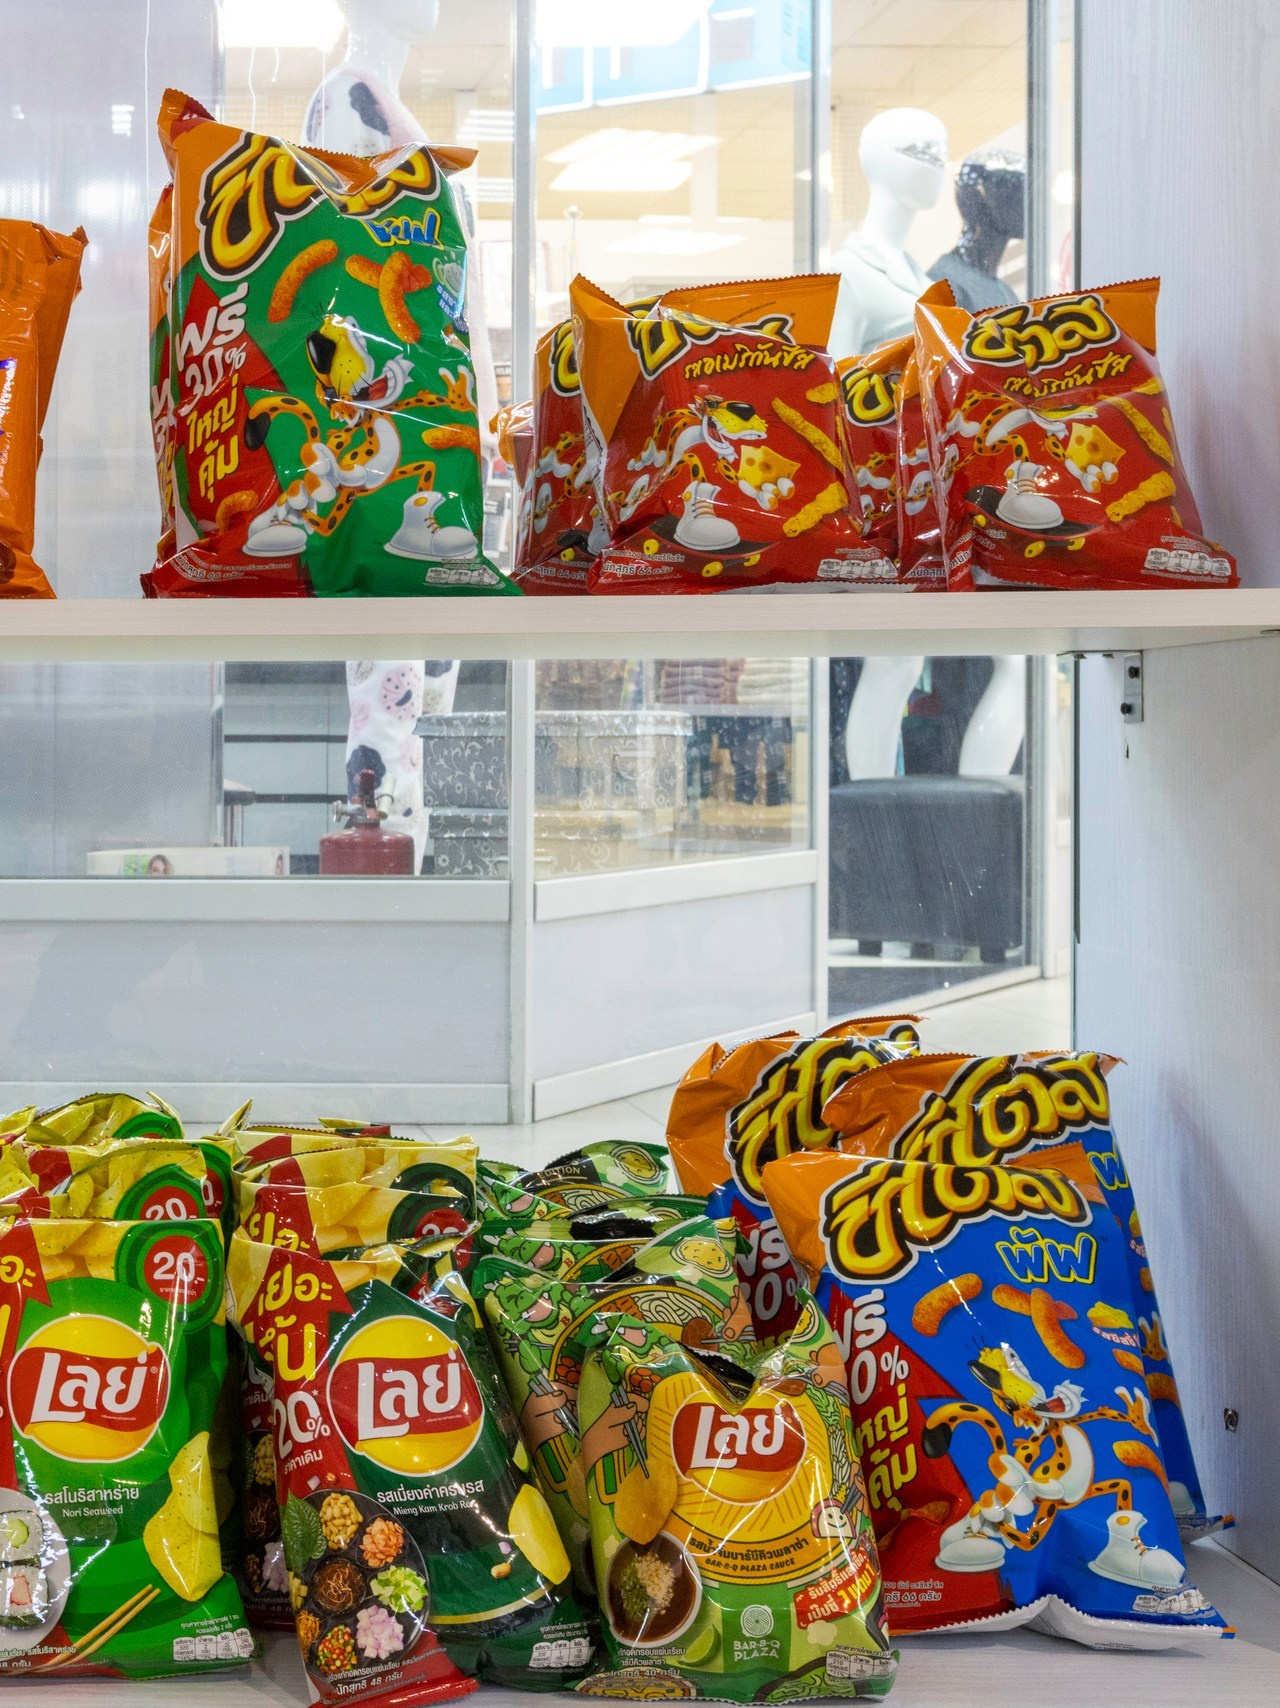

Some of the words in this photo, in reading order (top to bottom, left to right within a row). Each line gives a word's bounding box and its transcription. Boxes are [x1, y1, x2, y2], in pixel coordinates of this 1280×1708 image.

[176, 282, 249, 372] ฟรี
[178, 342, 248, 417] 30%
[186, 373, 239, 455] ใหญ่
[198, 434, 239, 503] คุ้ม
[996, 1225, 1098, 1283] พัฟ
[258, 1263, 332, 1316] เยอะ
[869, 1443, 918, 1512] คุ้ม
[45, 1484, 140, 1505] รสโนริสาหร่าย
[63, 1507, 82, 1518] Nori
[83, 1505, 124, 1517] Seaweed
[393, 1506, 418, 1516] Mieng
[419, 1505, 437, 1513] Kam
[438, 1502, 458, 1512] Krob
[705, 1558, 738, 1572] BAR-B-Q
[740, 1563, 768, 1572] PLAZA
[769, 1557, 795, 1571] SAUCE
[902, 1593, 917, 1601] 66
[919, 1591, 942, 1601] กรัม
[618, 1647, 686, 1657] ทอดกรอบแผ่นเรียบ
[733, 1640, 780, 1651] BAR-B-Q
[734, 1650, 779, 1662] PLAZA
[336, 1680, 367, 1695] นักสุทธิ
[370, 1677, 382, 1686] 48
[385, 1672, 403, 1683] กรัม
